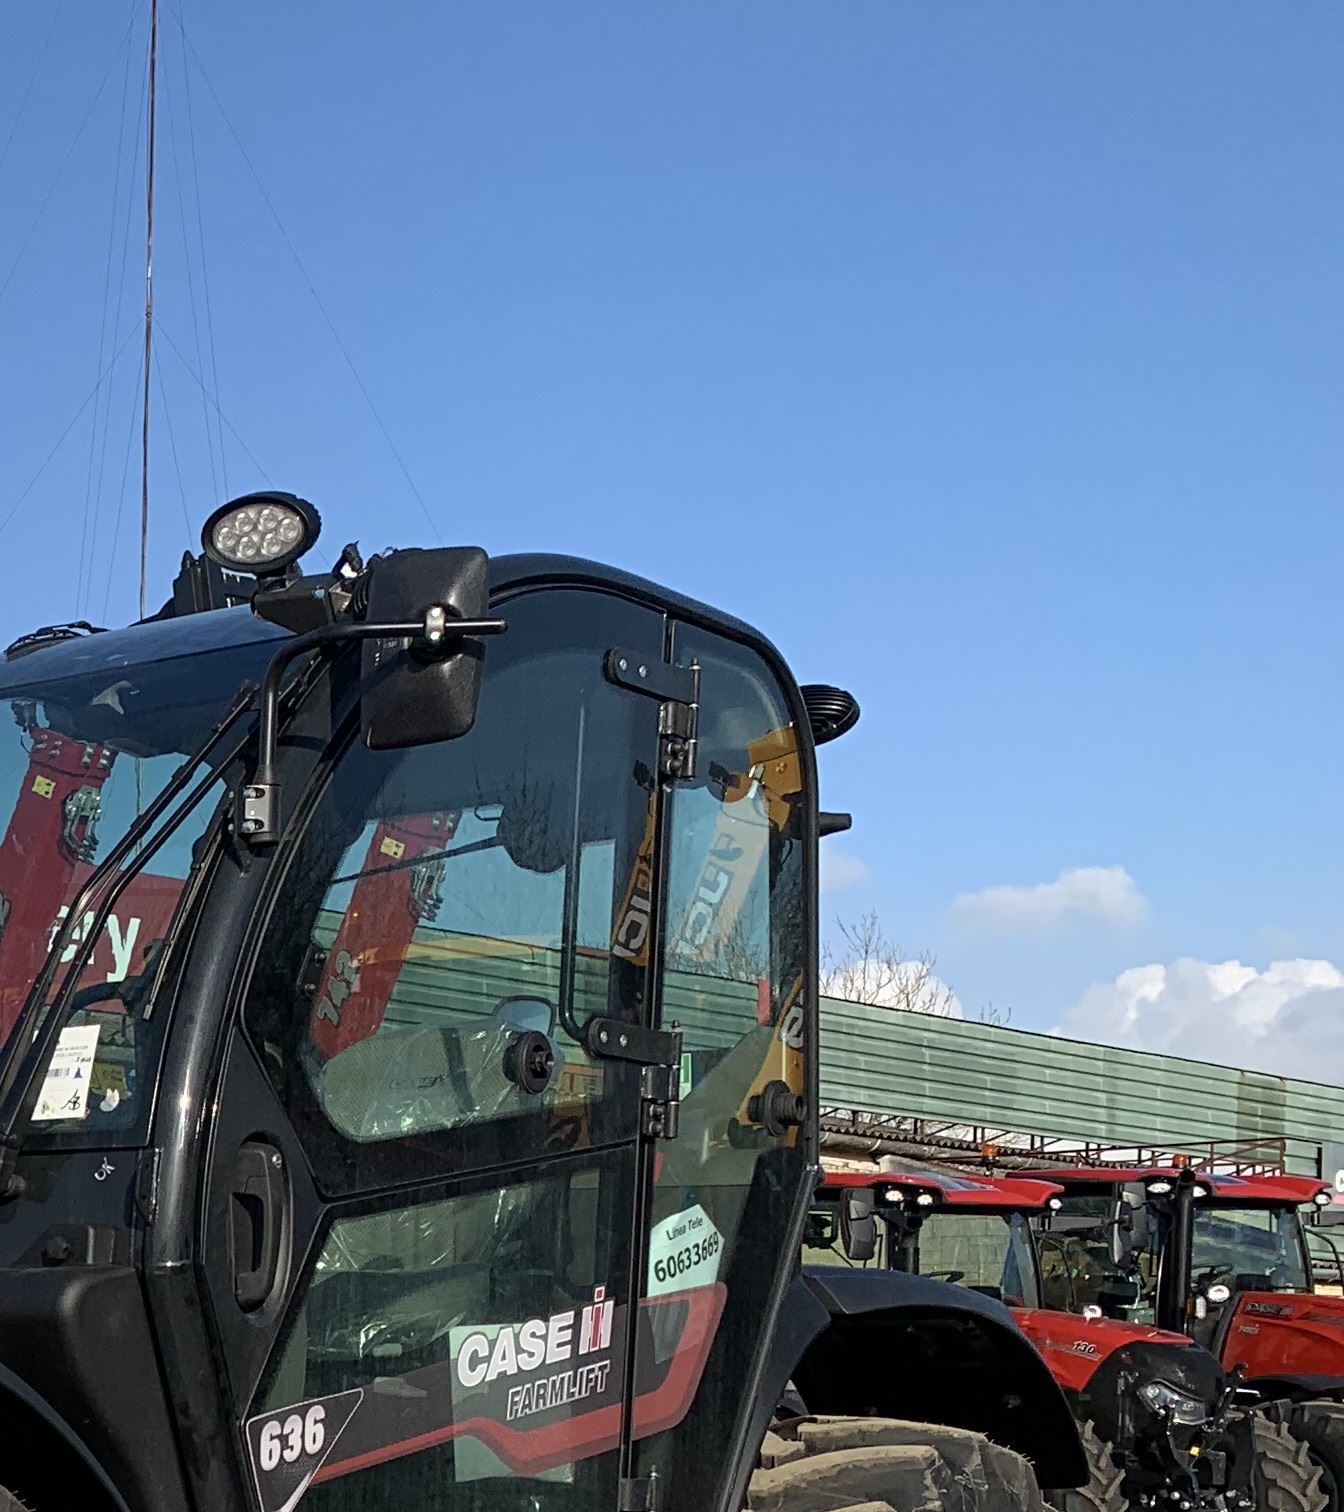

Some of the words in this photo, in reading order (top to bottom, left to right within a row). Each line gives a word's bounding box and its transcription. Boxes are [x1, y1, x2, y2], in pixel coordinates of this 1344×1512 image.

[653, 1231, 719, 1283] 60633669
[457, 1310, 575, 1388] CASE
[506, 1359, 611, 1421] FARMLIFT
[260, 1404, 326, 1471] 636
